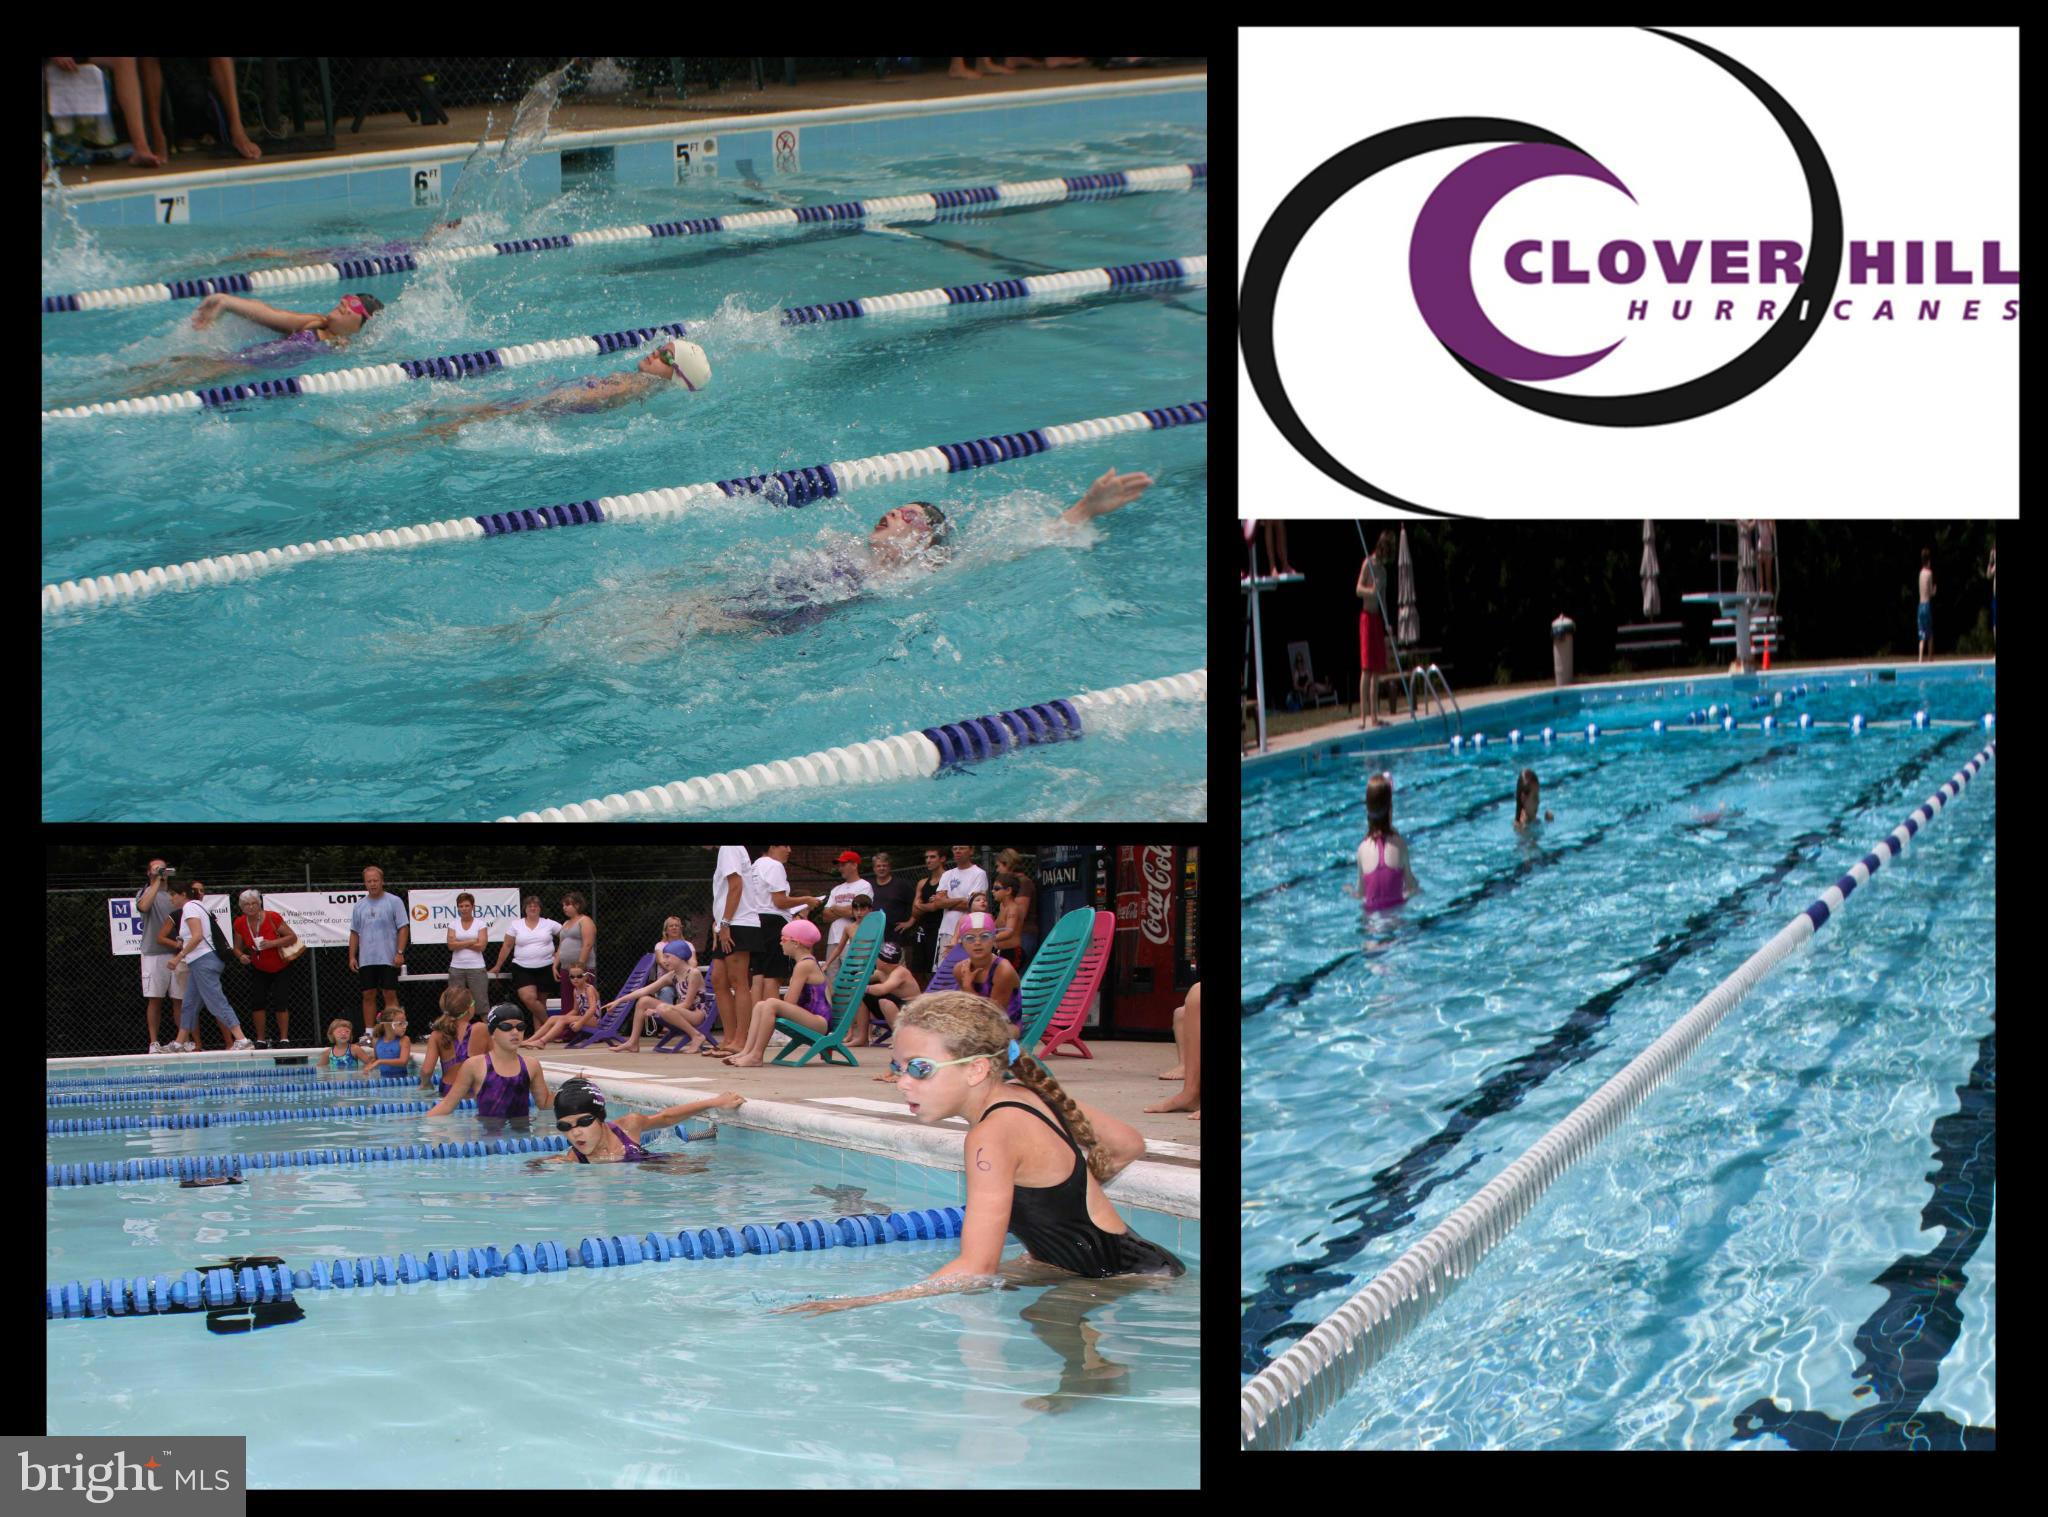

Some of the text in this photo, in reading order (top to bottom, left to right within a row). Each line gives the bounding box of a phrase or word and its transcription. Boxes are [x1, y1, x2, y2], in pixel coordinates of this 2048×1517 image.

[690, 142, 699, 152] FT
[414, 170, 428, 190] 6
[160, 197, 174, 225] 7
[1504, 239, 2020, 285] CLOVER HILL
[1627, 299, 2019, 321] HURRICANES
[1042, 866, 1077, 886] DASANI
[114, 904, 128, 915] M
[473, 903, 519, 919] BANK
[119, 922, 128, 931] D
[976, 1147, 992, 1172] 6
